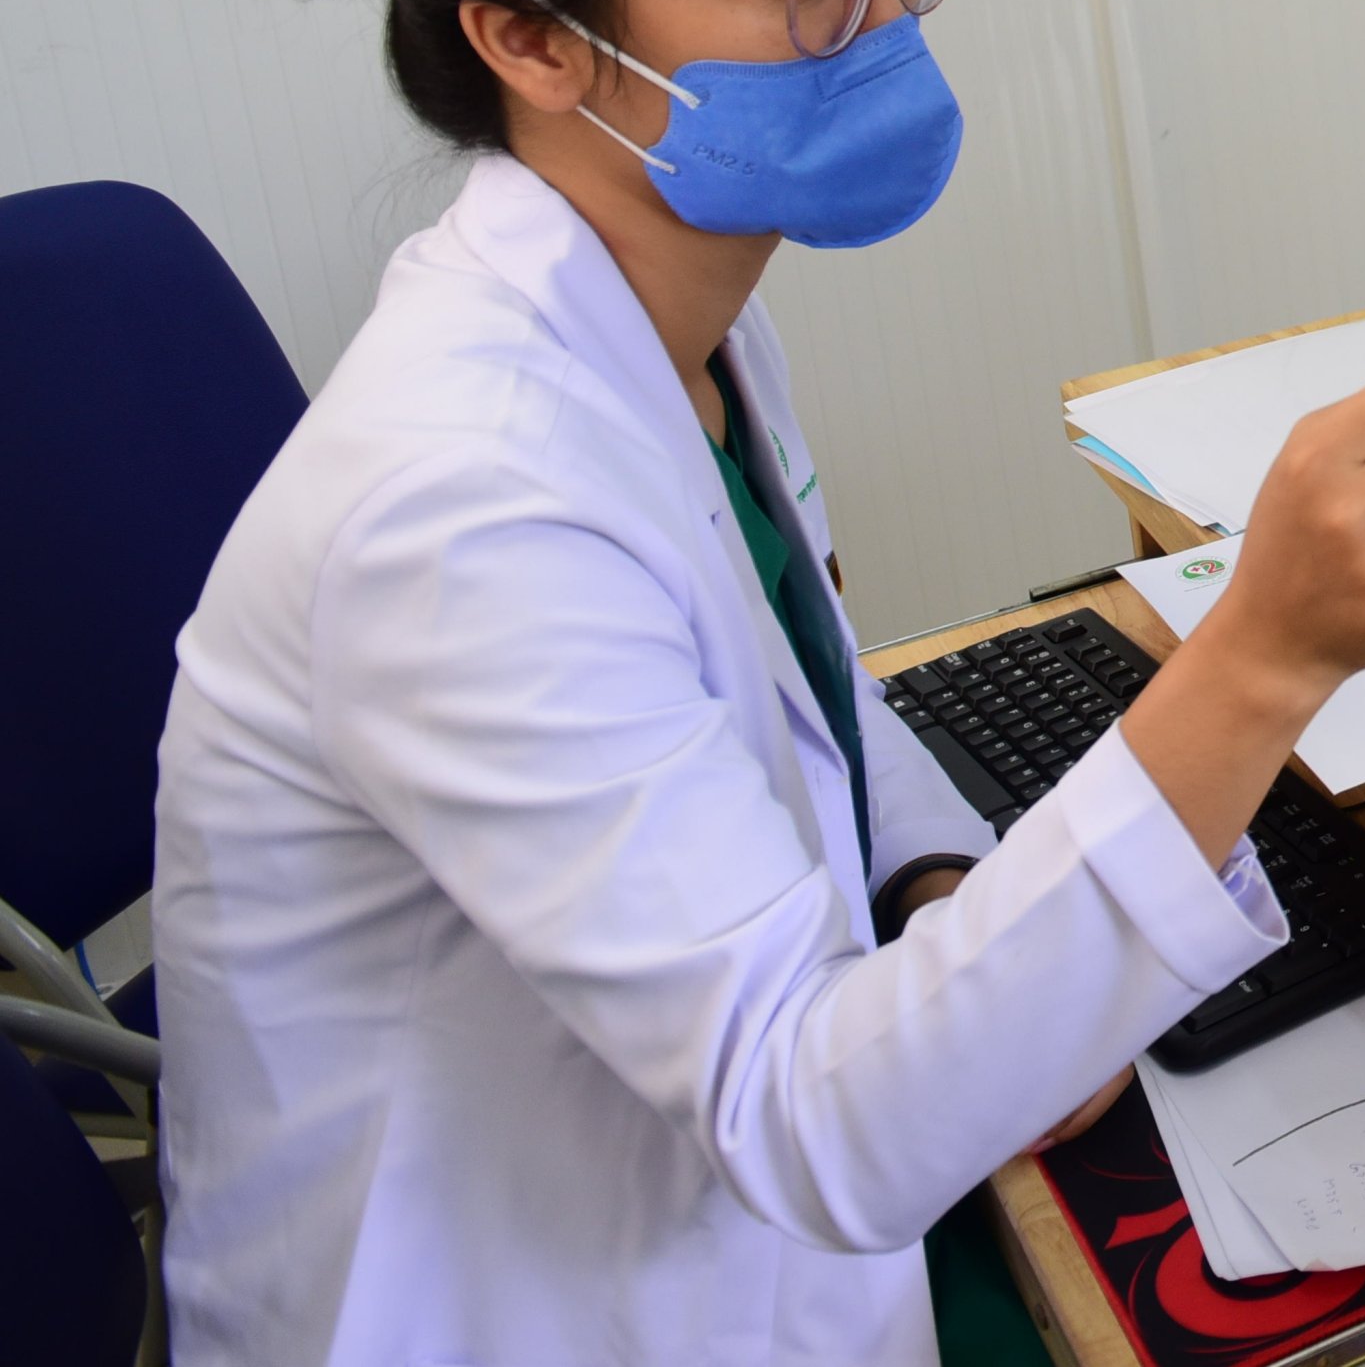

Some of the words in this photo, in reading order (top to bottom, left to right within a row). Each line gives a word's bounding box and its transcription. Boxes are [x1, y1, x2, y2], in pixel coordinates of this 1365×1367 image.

[1023, 721, 1033, 729] G
[1081, 729, 1091, 737] U
[1035, 734, 1047, 742] H
[1008, 755, 1019, 763] N
